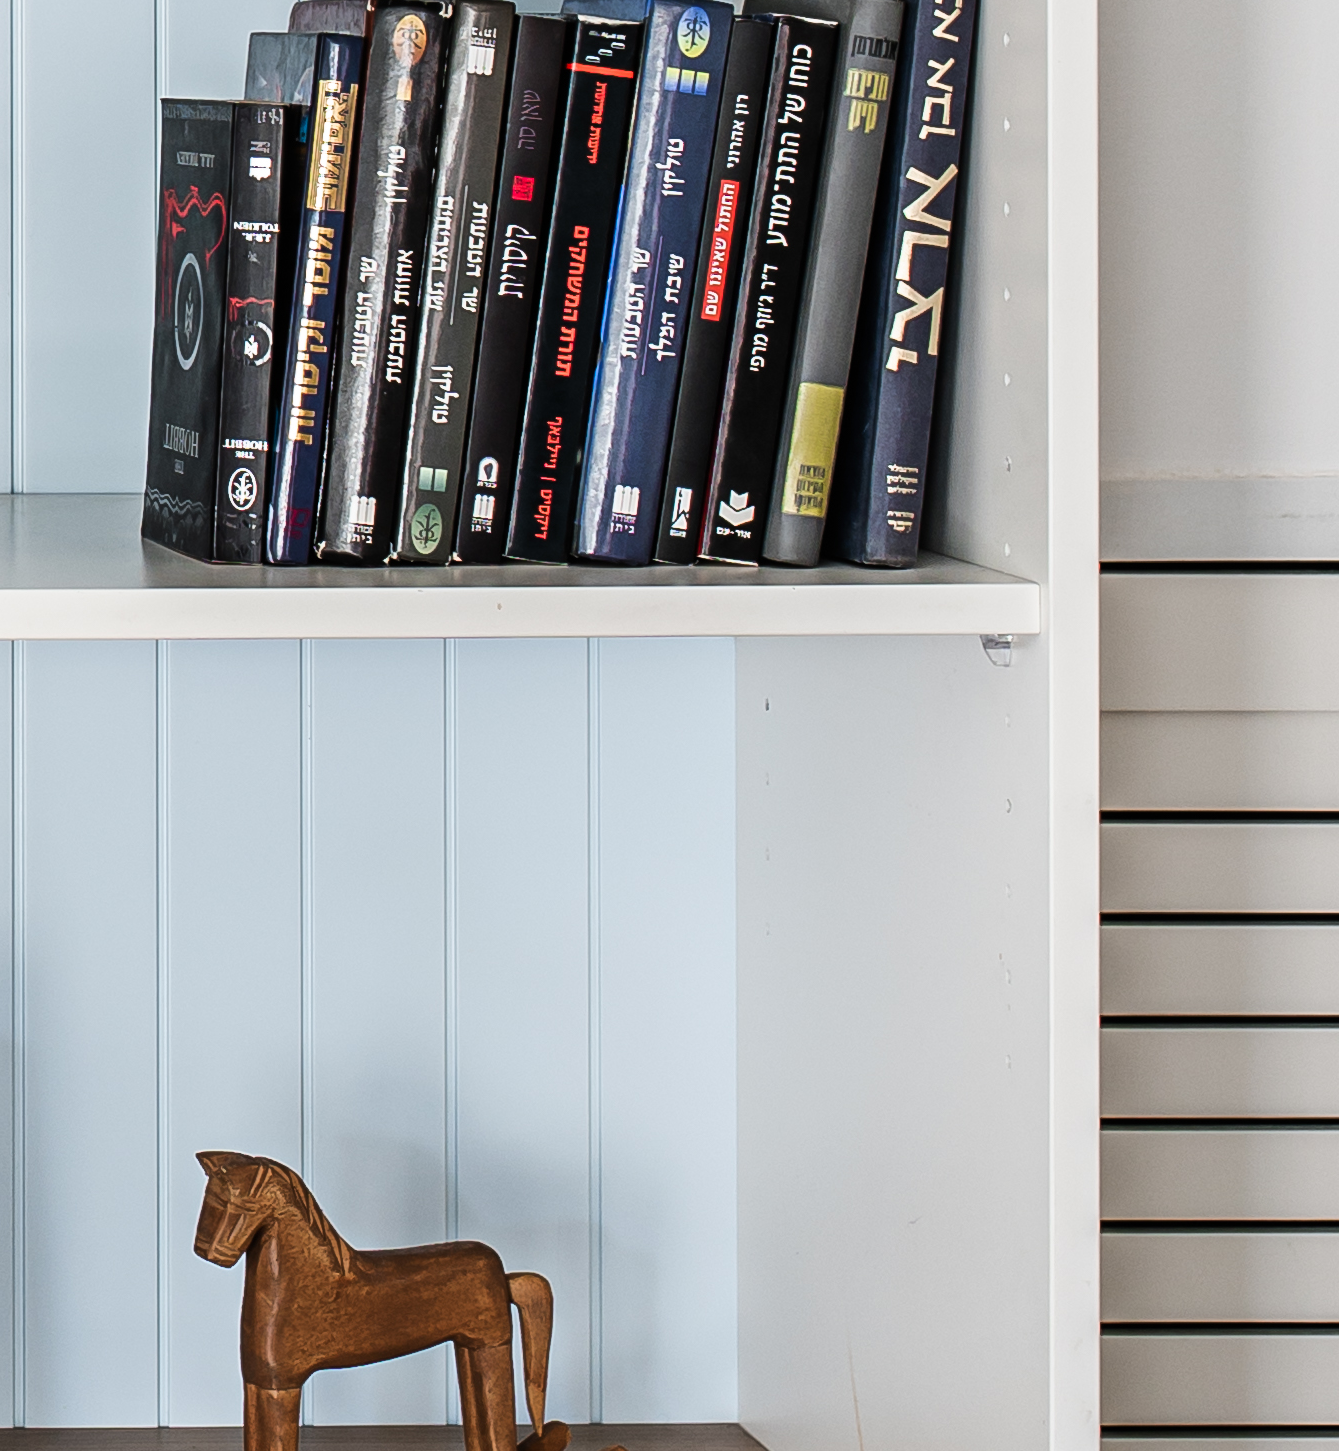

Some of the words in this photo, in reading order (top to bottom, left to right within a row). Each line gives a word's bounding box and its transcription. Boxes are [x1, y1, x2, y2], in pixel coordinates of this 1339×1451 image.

[520, 89, 542, 121] שאן
[733, 94, 749, 115] רון
[918, 58, 955, 140] אבן
[517, 126, 536, 150] סה
[725, 121, 745, 169] אהרוני
[377, 145, 409, 205] טולקין
[233, 221, 280, 233] TOLKIEN
[431, 195, 455, 272] הצריחים
[714, 184, 735, 233] החתול
[466, 201, 490, 277] הטבעות
[498, 224, 536, 299] קיסרית
[709, 238, 726, 286] שאיננו
[301, 226, 336, 305] מוסד
[359, 257, 379, 283] שר
[393, 249, 414, 306] אחוות
[561, 225, 591, 321] המשחקים
[664, 253, 684, 304] שיבת
[884, 163, 959, 372] ארצי
[427, 281, 446, 311] שני
[462, 287, 479, 313] שר
[704, 290, 719, 315] שם
[350, 292, 373, 369] הטבעות
[385, 314, 407, 384] הטבעת
[554, 326, 577, 377] תורת
[648, 312, 676, 361] המלך
[287, 318, 328, 445] וקיסרות
[430, 365, 460, 424] טולקין
[163, 423, 199, 459] HOBBIT
[222, 438, 268, 451] HOBBIT
